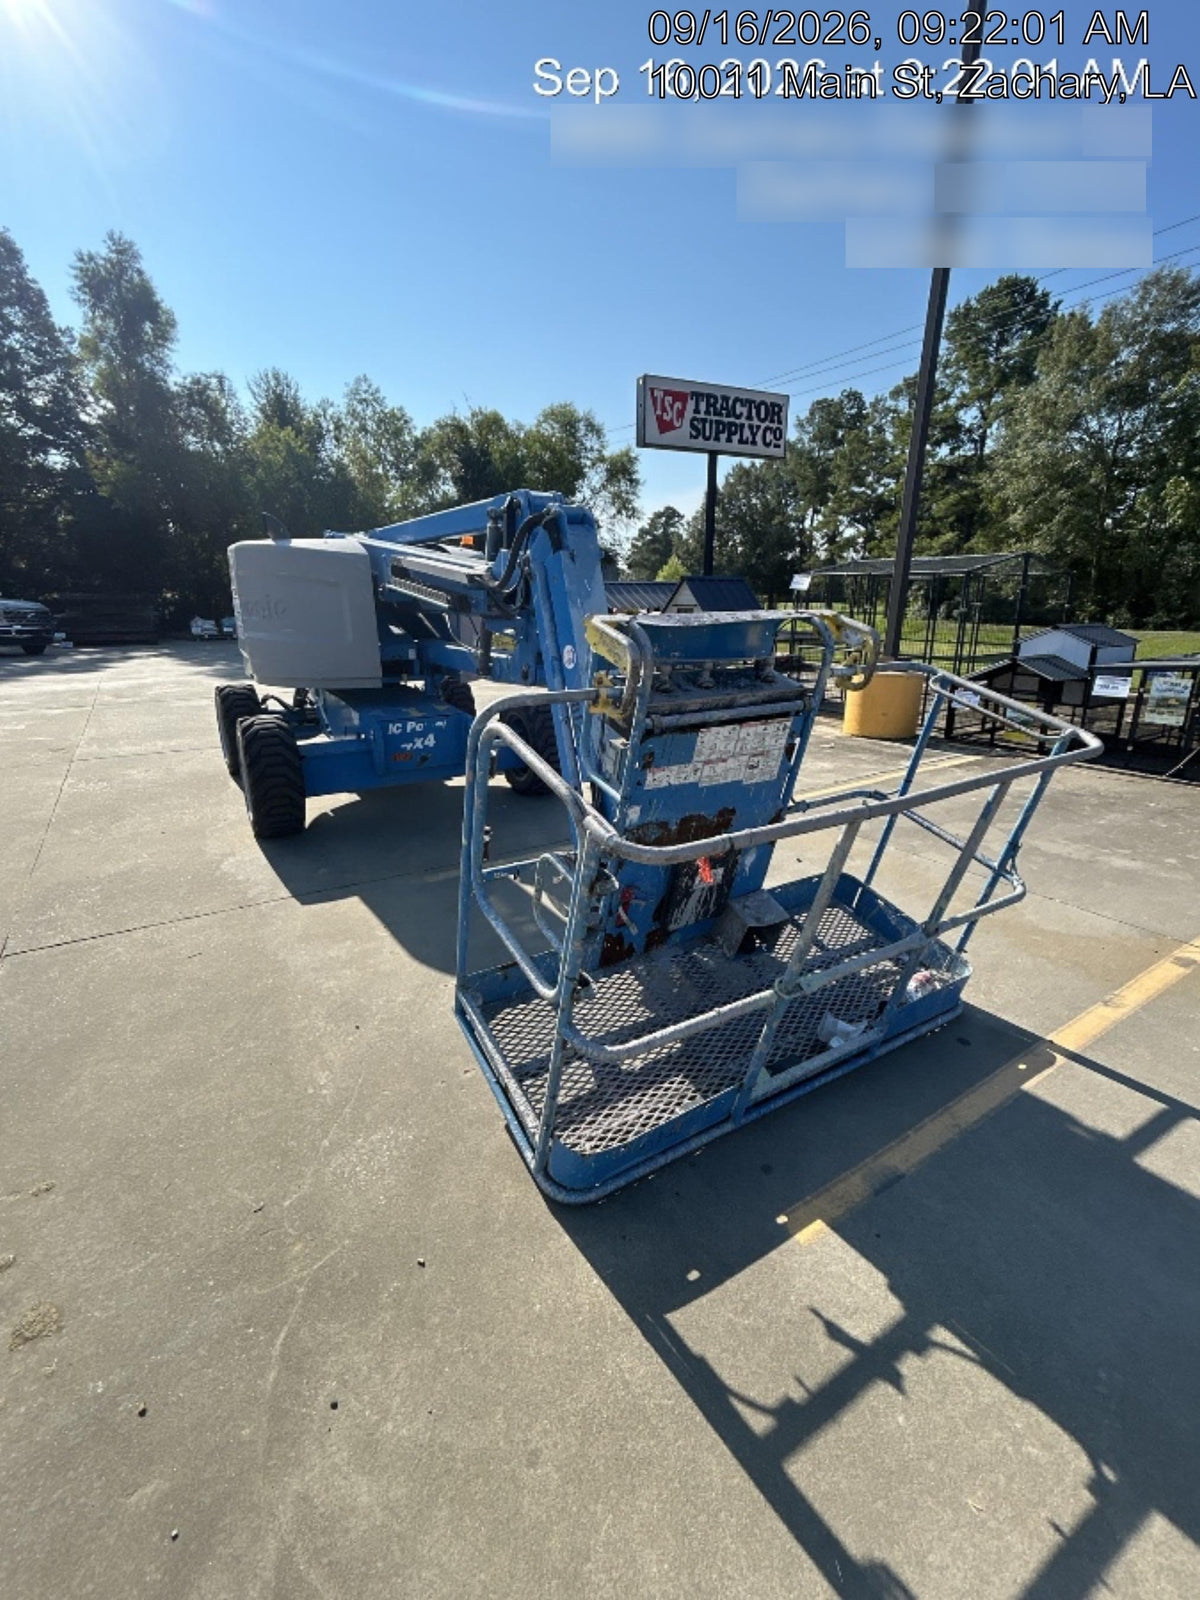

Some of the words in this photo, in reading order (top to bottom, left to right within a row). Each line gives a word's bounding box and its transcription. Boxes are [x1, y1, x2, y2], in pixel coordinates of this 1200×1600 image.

[653, 388, 683, 428] TSC
[689, 390, 783, 426] TRACTOR
[689, 416, 762, 447] SUPPLY
